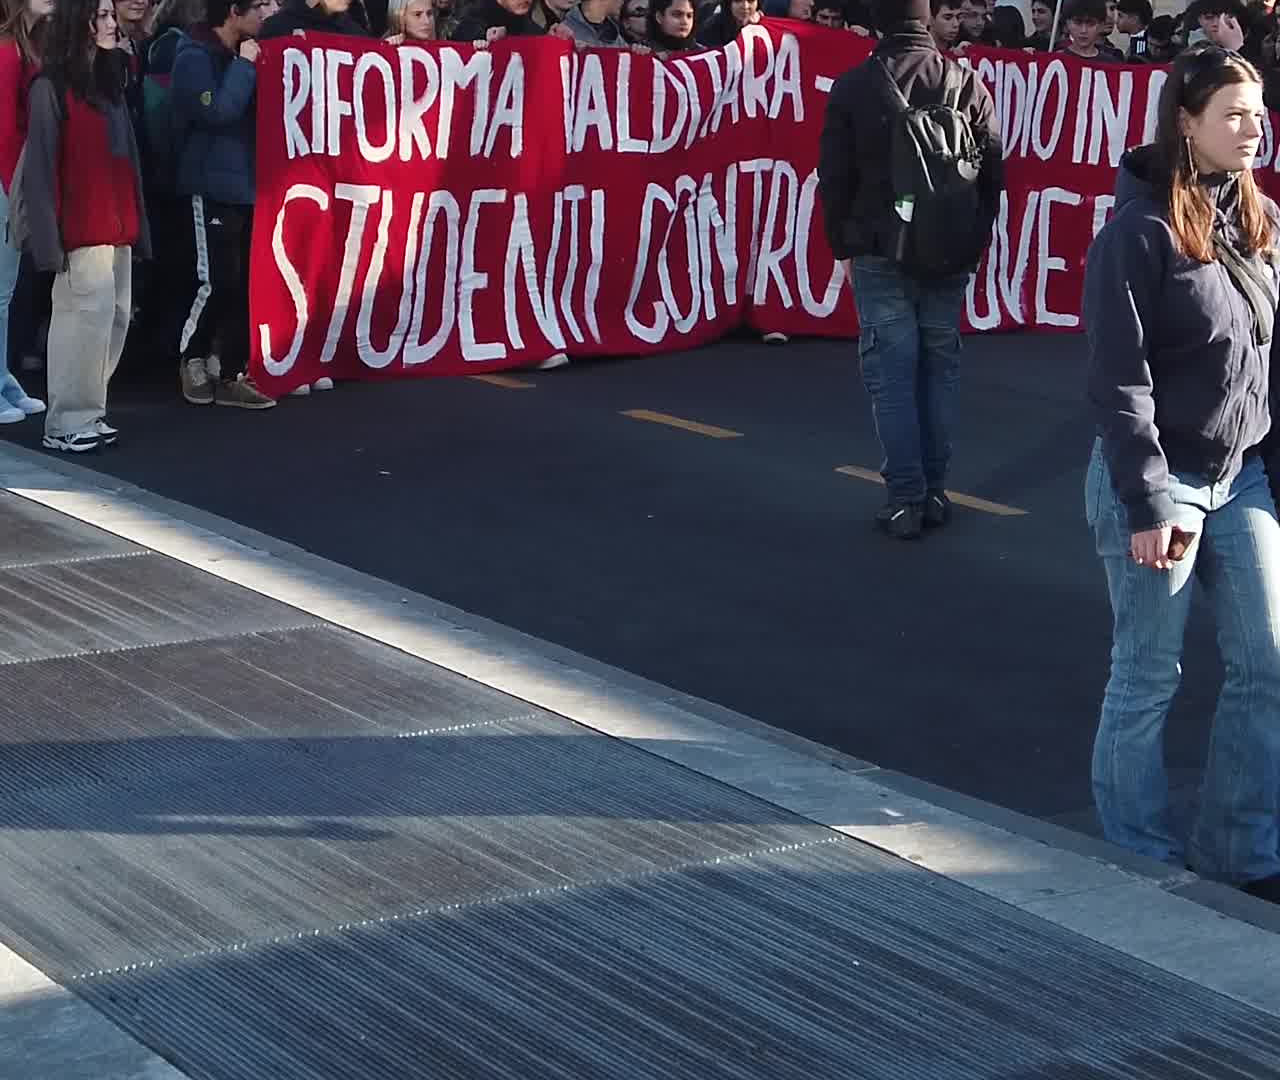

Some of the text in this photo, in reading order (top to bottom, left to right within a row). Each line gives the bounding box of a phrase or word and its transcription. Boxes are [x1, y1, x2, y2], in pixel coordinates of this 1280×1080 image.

[282, 46, 526, 162] RIFORMA
[560, 25, 805, 154] VALDITARA
[1072, 66, 1132, 168] IN
[259, 183, 607, 376] STUDENTI
[625, 158, 847, 344] CONTRO
